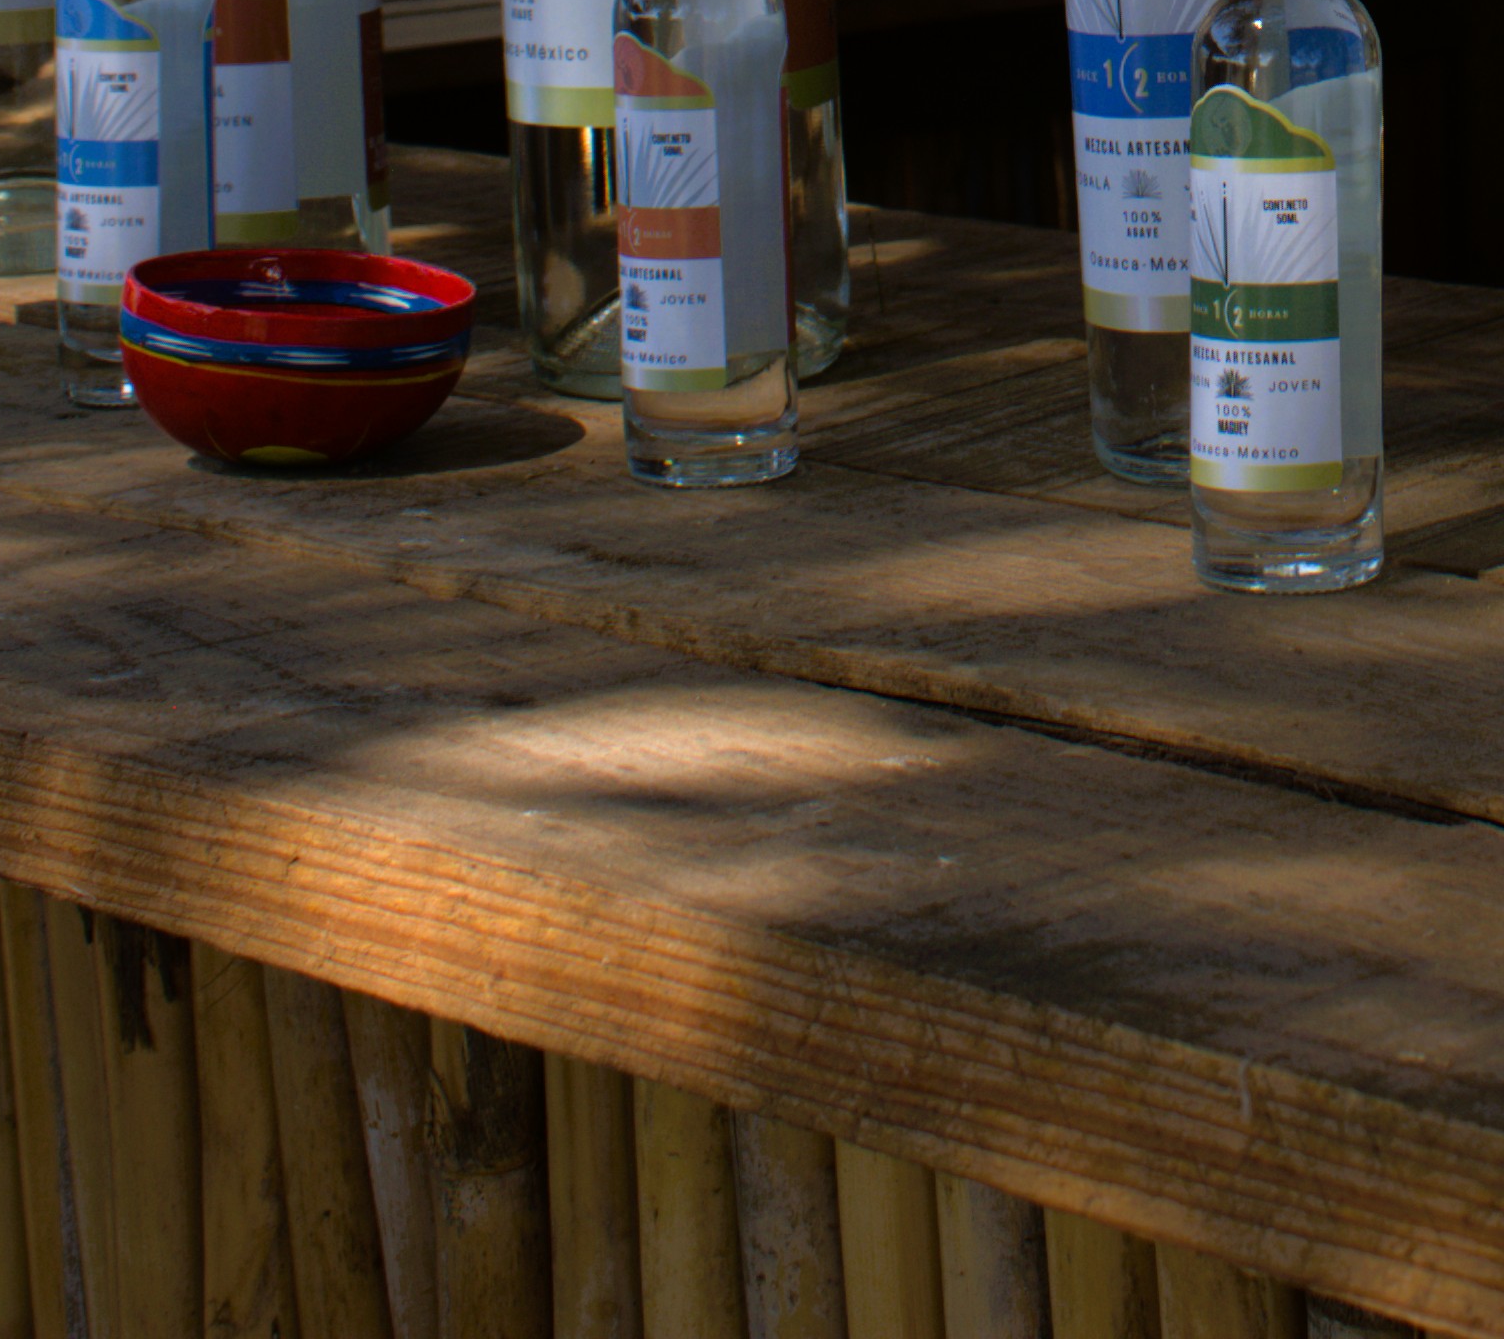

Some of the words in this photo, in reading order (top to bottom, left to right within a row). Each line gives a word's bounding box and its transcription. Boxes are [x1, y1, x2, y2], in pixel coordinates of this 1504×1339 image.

[1156, 71, 1187, 84] HOR
[1085, 136, 1122, 156] MEZCAL
[1127, 139, 1191, 156] ARTESAN
[1263, 199, 1308, 211] CONT.NETO
[100, 216, 144, 228] JOVEN
[1123, 210, 1162, 224] 100%
[1277, 213, 1299, 224] 50ML
[1126, 226, 1159, 239] AGAVE
[1089, 250, 1189, 271] Oaxaca-Méx
[660, 293, 706, 305] JOVEN
[1249, 308, 1289, 320] HORAS
[1226, 350, 1296, 365] ARTESANAL
[1269, 379, 1321, 392] JOVEN
[1216, 404, 1251, 417] 100%
[1218, 419, 1248, 435] MAGUEY
